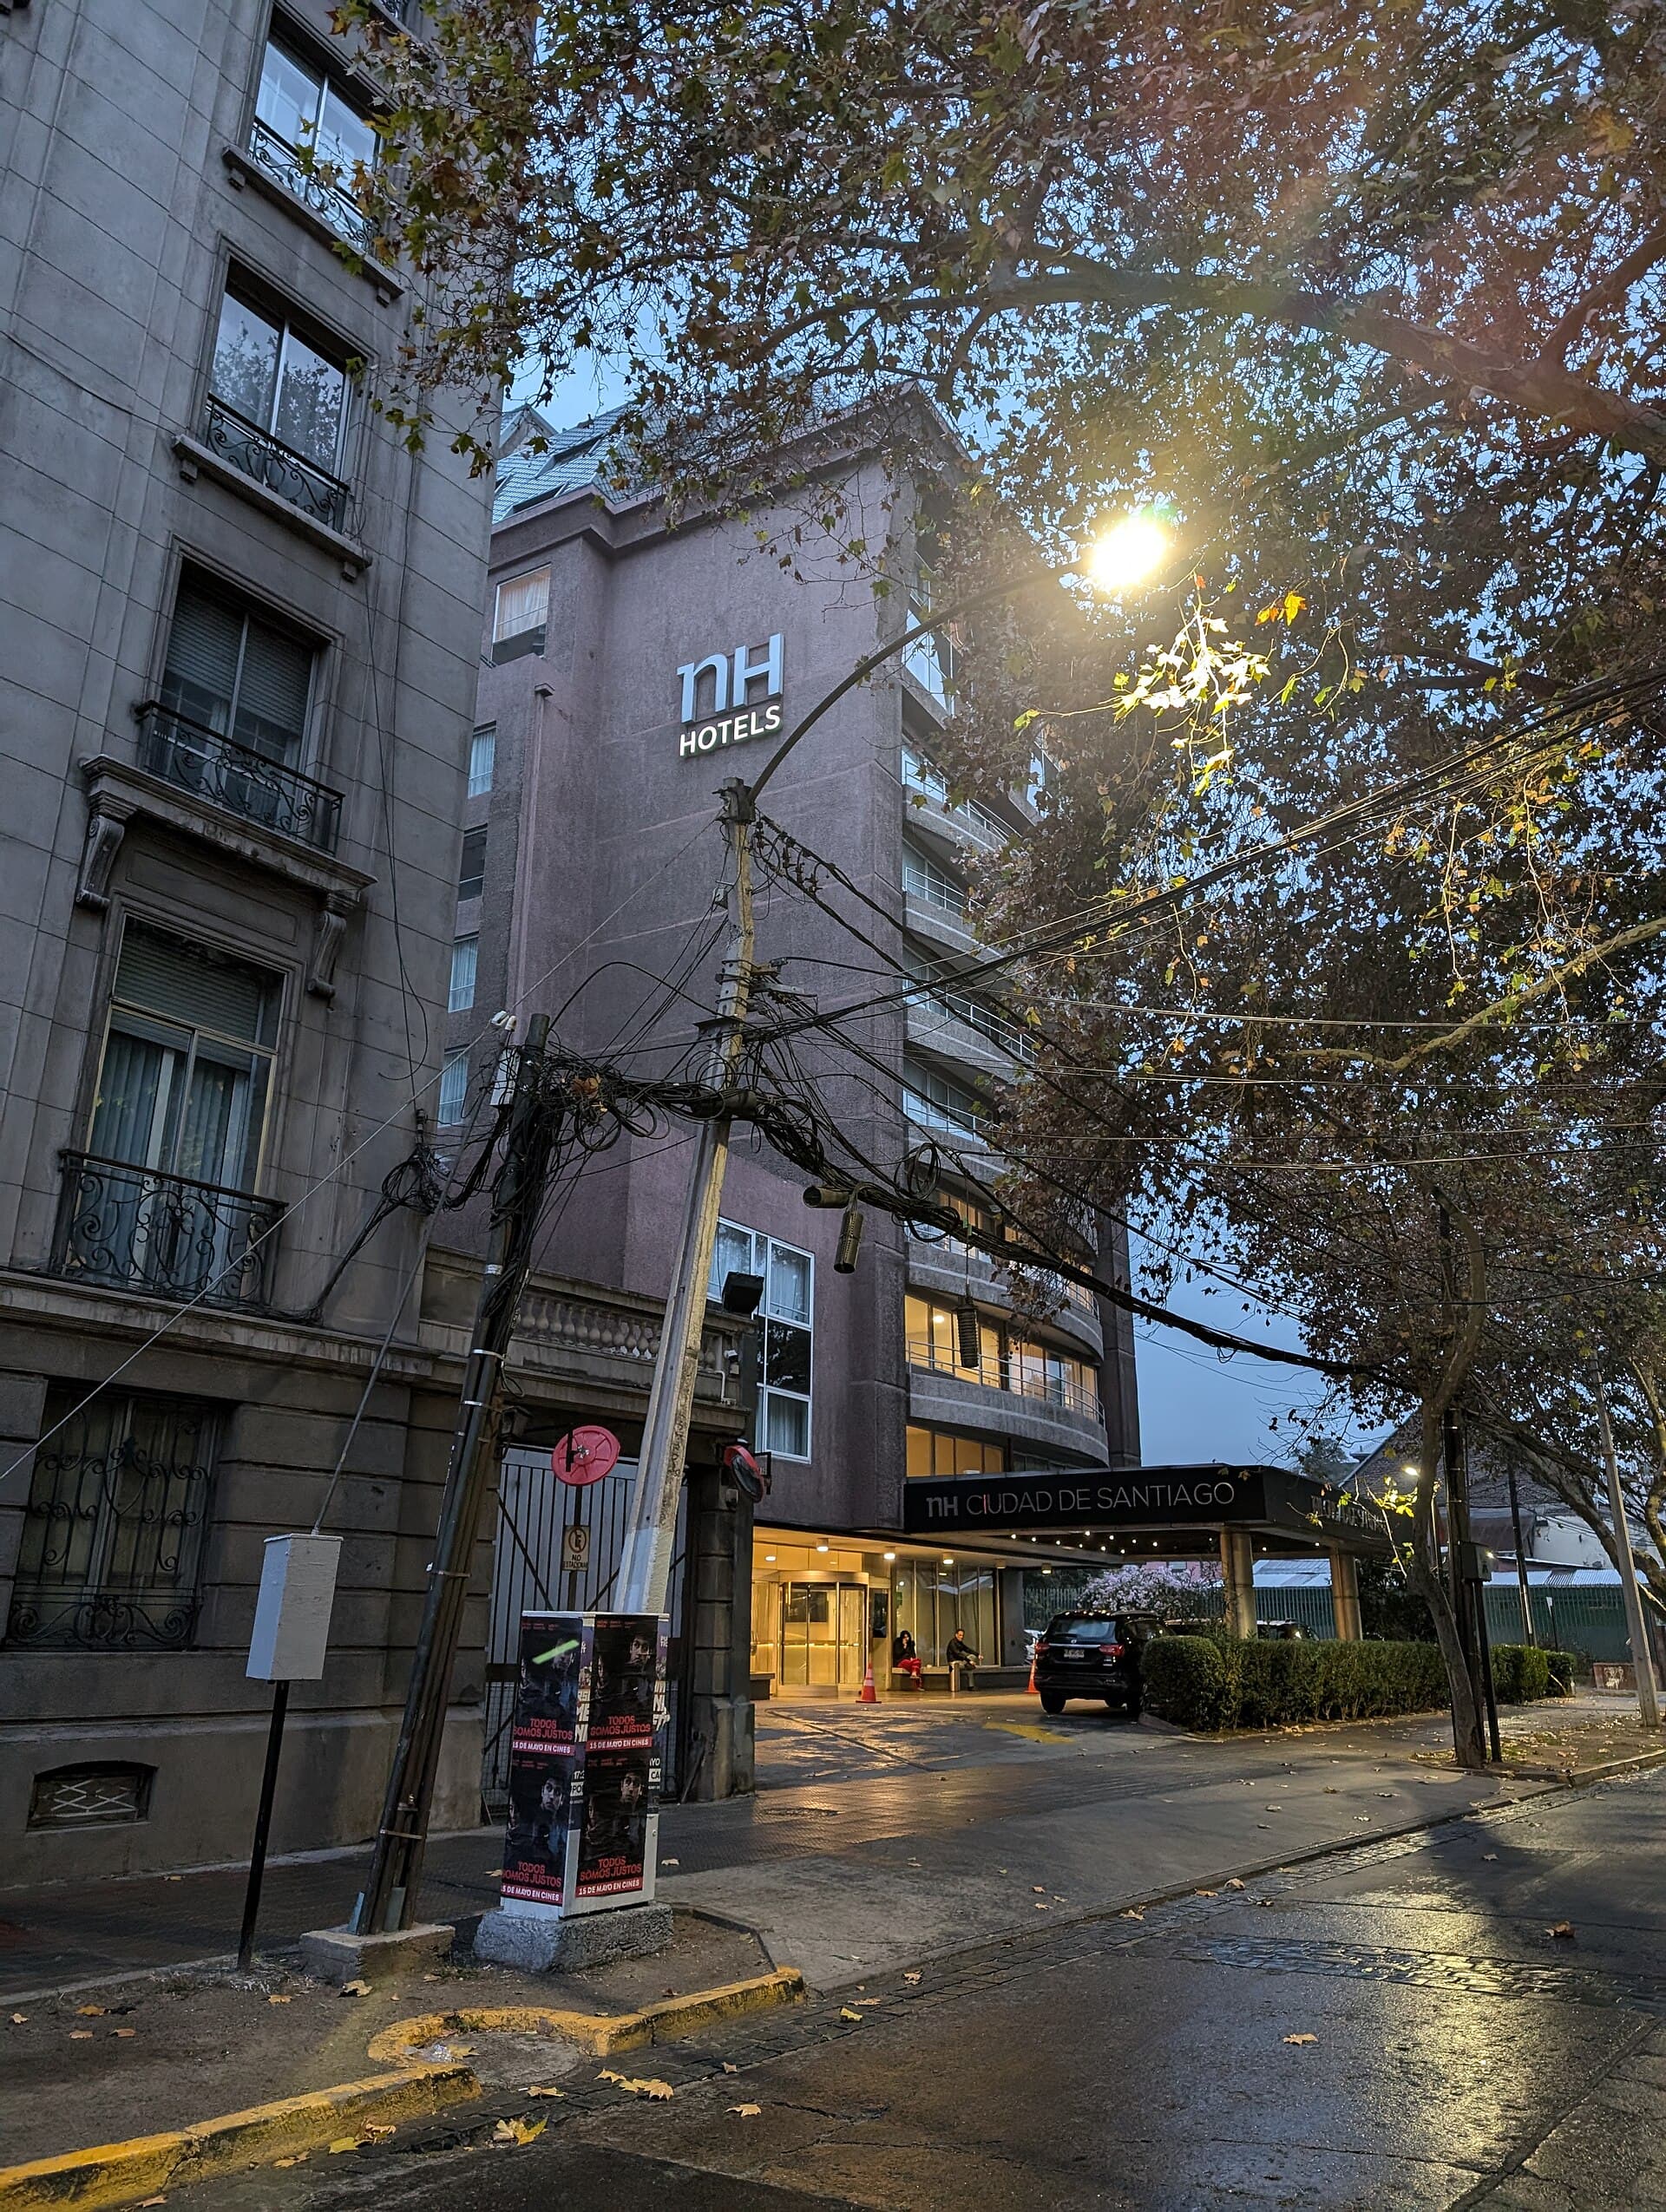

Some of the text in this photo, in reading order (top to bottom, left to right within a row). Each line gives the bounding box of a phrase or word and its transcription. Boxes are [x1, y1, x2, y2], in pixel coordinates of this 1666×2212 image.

[679, 705, 781, 756] HOTELS
[966, 1491, 1053, 1515] CIUDAD
[1059, 1489, 1092, 1511] DE
[1097, 1482, 1235, 1509] SANTIAGO
[530, 1718, 557, 1729] TODOS
[608, 1715, 635, 1725] TODOS
[542, 1729, 573, 1740] JUSTOS
[590, 1724, 651, 1736] SOMOS JUSTOS
[553, 1745, 571, 1754] CINES
[518, 1861, 546, 1875] TODOS
[599, 1855, 626, 1868] TODOS
[580, 1863, 642, 1882] SOMOS JUSTOS
[529, 1874, 562, 1888] JUSTOS
[579, 1887, 587, 1895] 15
[596, 1883, 613, 1892] MAYO
[613, 1882, 621, 1890] EN
[622, 1879, 640, 1888] CINES
[515, 1887, 532, 1896] MAYO
[541, 1891, 560, 1901] CINES
